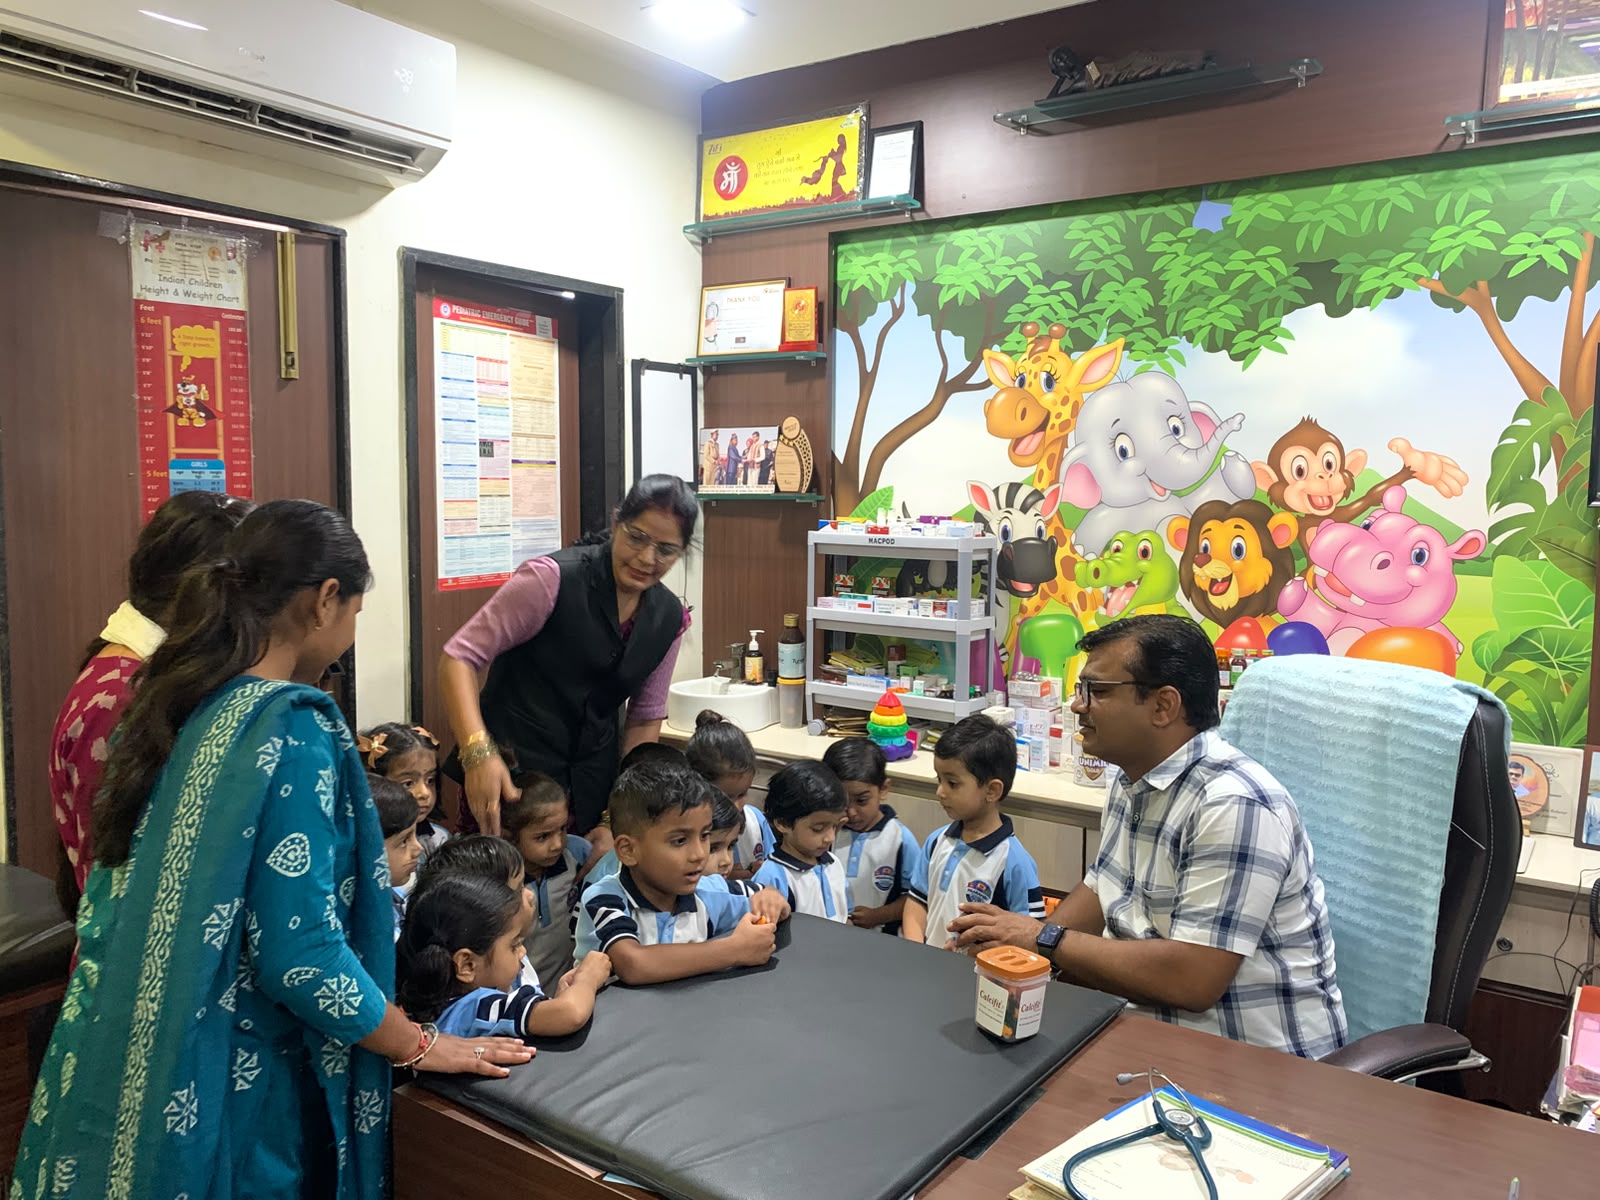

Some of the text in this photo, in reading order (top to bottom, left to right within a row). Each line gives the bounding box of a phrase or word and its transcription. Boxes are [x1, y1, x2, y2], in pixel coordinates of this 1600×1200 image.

[158, 274, 223, 290] Indian Children
[140, 284, 240, 304] Height & Weight Chart
[139, 304, 155, 312] Feet
[451, 304, 482, 318] PEDIATRIC
[482, 310, 514, 324] EMERGENCY
[146, 317, 162, 326] feet
[152, 470, 168, 478] feet
[868, 537, 896, 545] MACPOD
[979, 990, 1002, 1009] Calcifit
